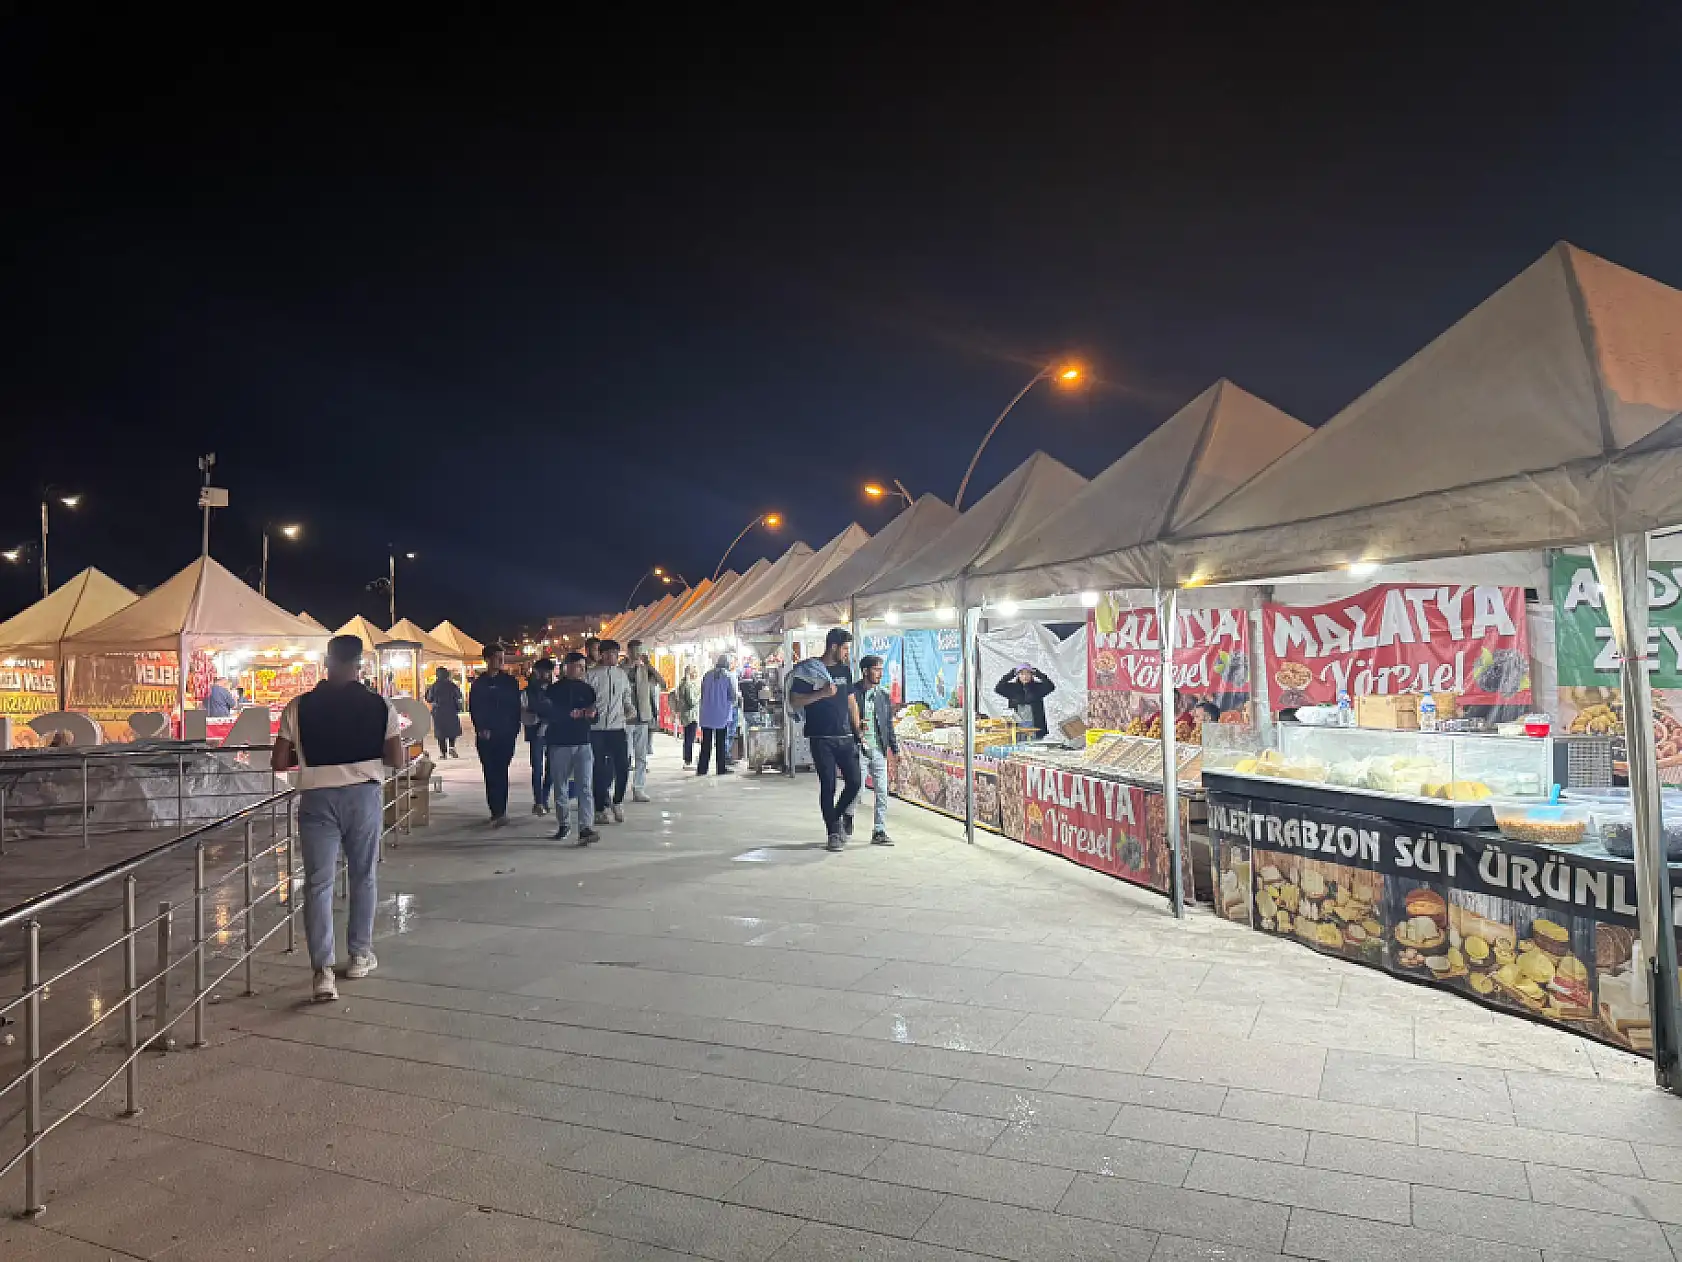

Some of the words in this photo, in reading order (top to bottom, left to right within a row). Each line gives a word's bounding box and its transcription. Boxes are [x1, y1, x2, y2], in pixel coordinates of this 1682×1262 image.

[1273, 586, 1516, 658] MALATYA
[1120, 653, 1210, 689] Yörsel
[1320, 651, 1466, 698] Yöresel
[1026, 766, 1136, 825] MALATYA
[1045, 807, 1113, 862] Yöresel
[1251, 812, 1381, 863] TRABZON
[1394, 831, 1464, 878] SÜT
[1478, 843, 1682, 925] ÜRÜNL
